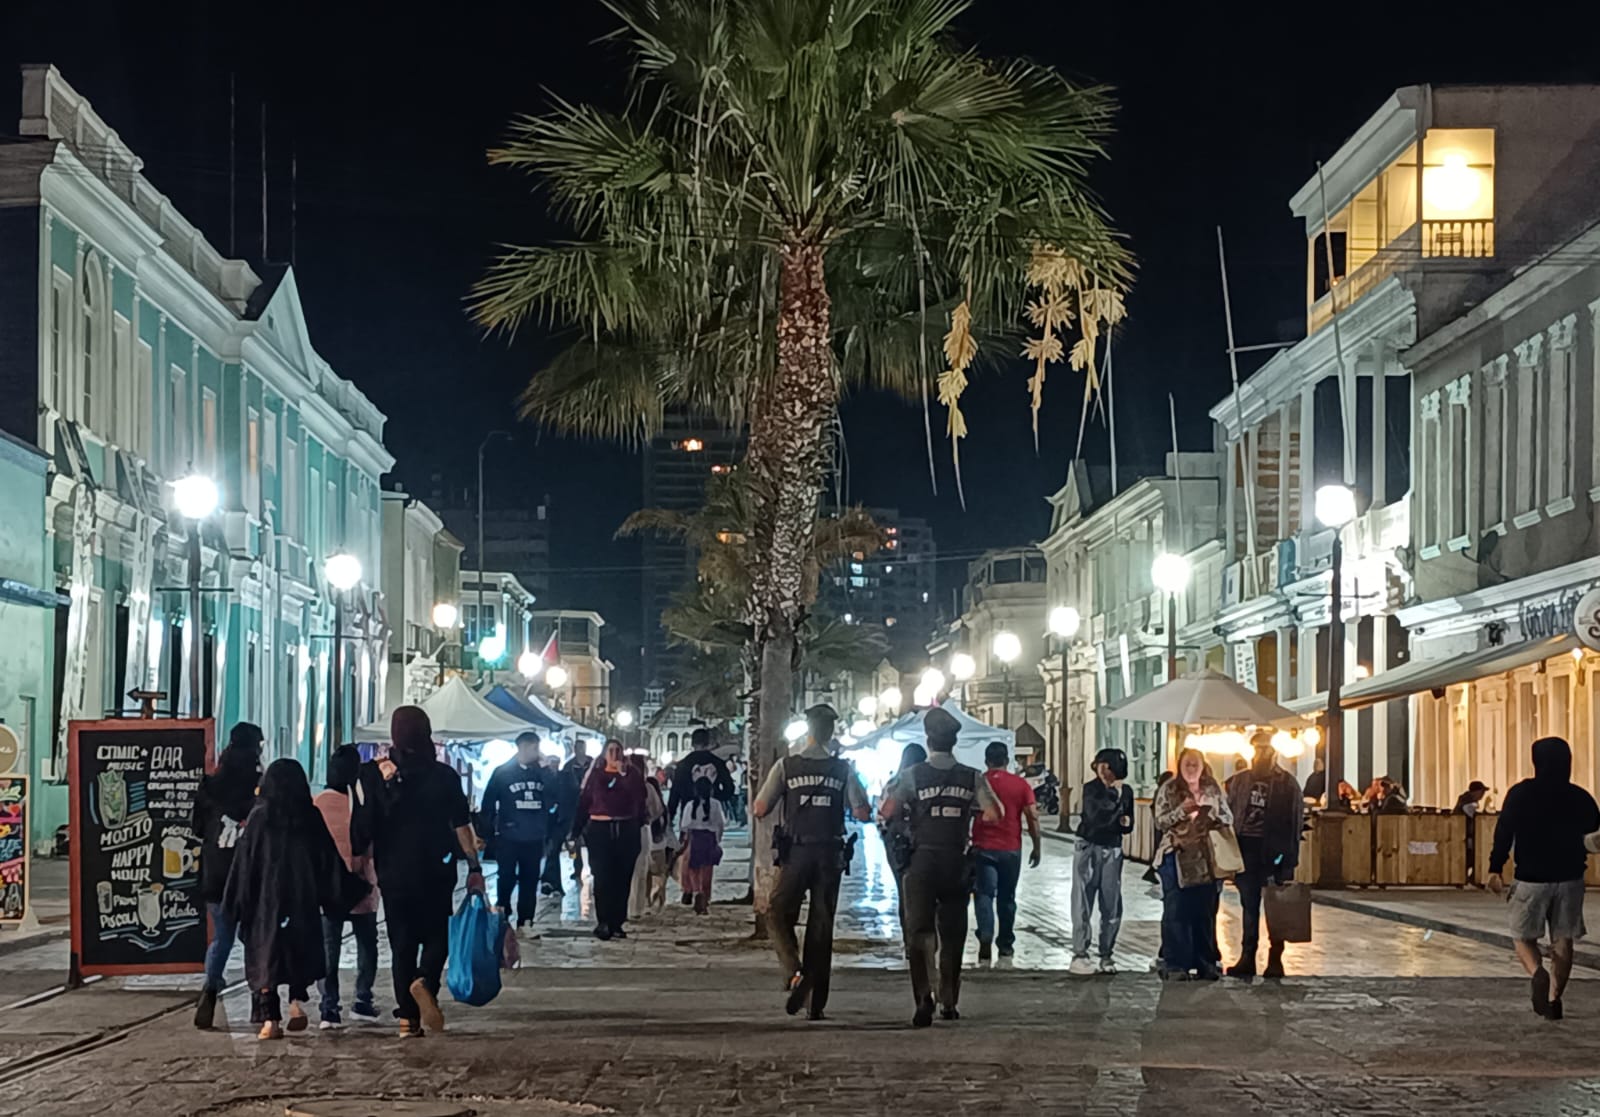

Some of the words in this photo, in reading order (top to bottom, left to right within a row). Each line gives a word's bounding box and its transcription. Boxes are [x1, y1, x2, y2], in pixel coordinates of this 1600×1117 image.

[106, 761, 145, 771] MUSIC
[150, 746, 183, 769] BAR
[100, 817, 153, 845] MOJITO
[111, 842, 154, 868] HAPPY
[111, 868, 152, 882] HOUR
